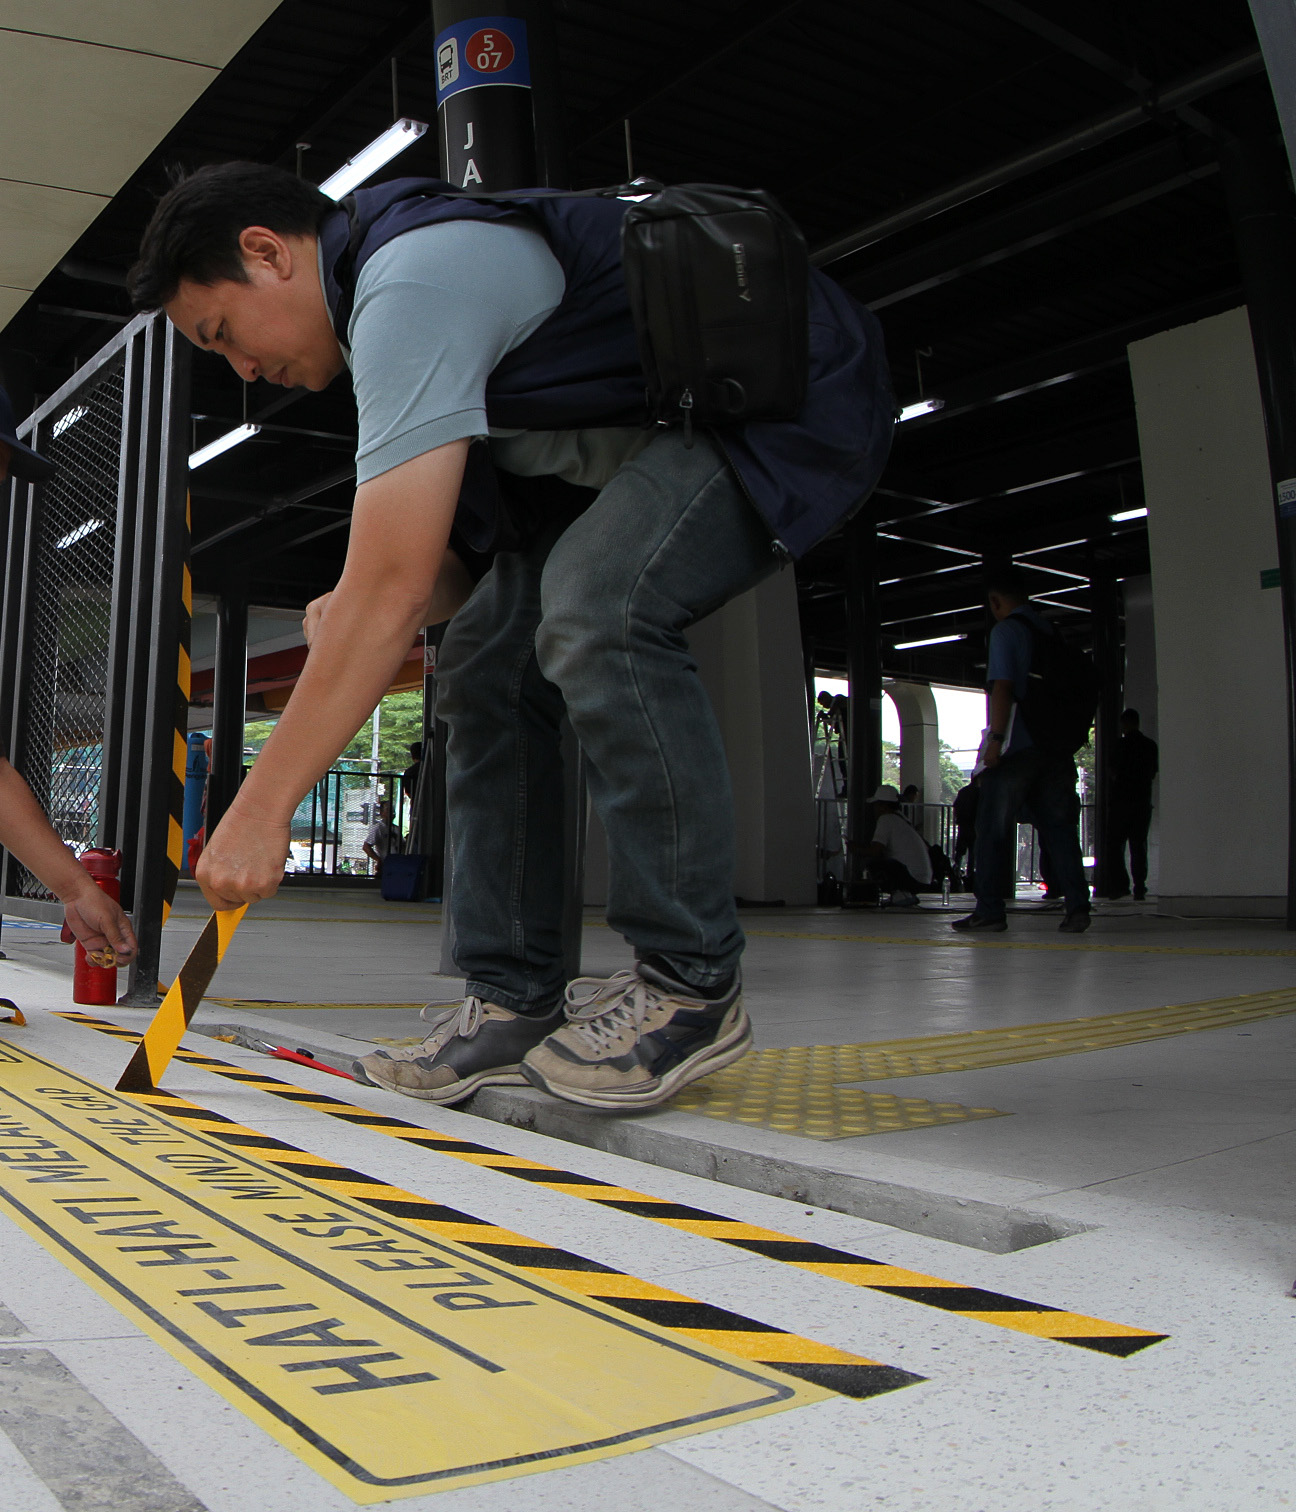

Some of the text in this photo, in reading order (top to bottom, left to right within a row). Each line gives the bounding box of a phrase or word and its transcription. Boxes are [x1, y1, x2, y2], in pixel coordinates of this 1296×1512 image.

[483, 34, 495, 52] 5
[476, 52, 503, 70] 07
[441, 69, 454, 85] BRT
[1279, 490, 1296, 502] 1500
[35, 1087, 539, 1312] PLEASE MIND THE GAP
[51, 1196, 441, 1396] HATI-HATI
